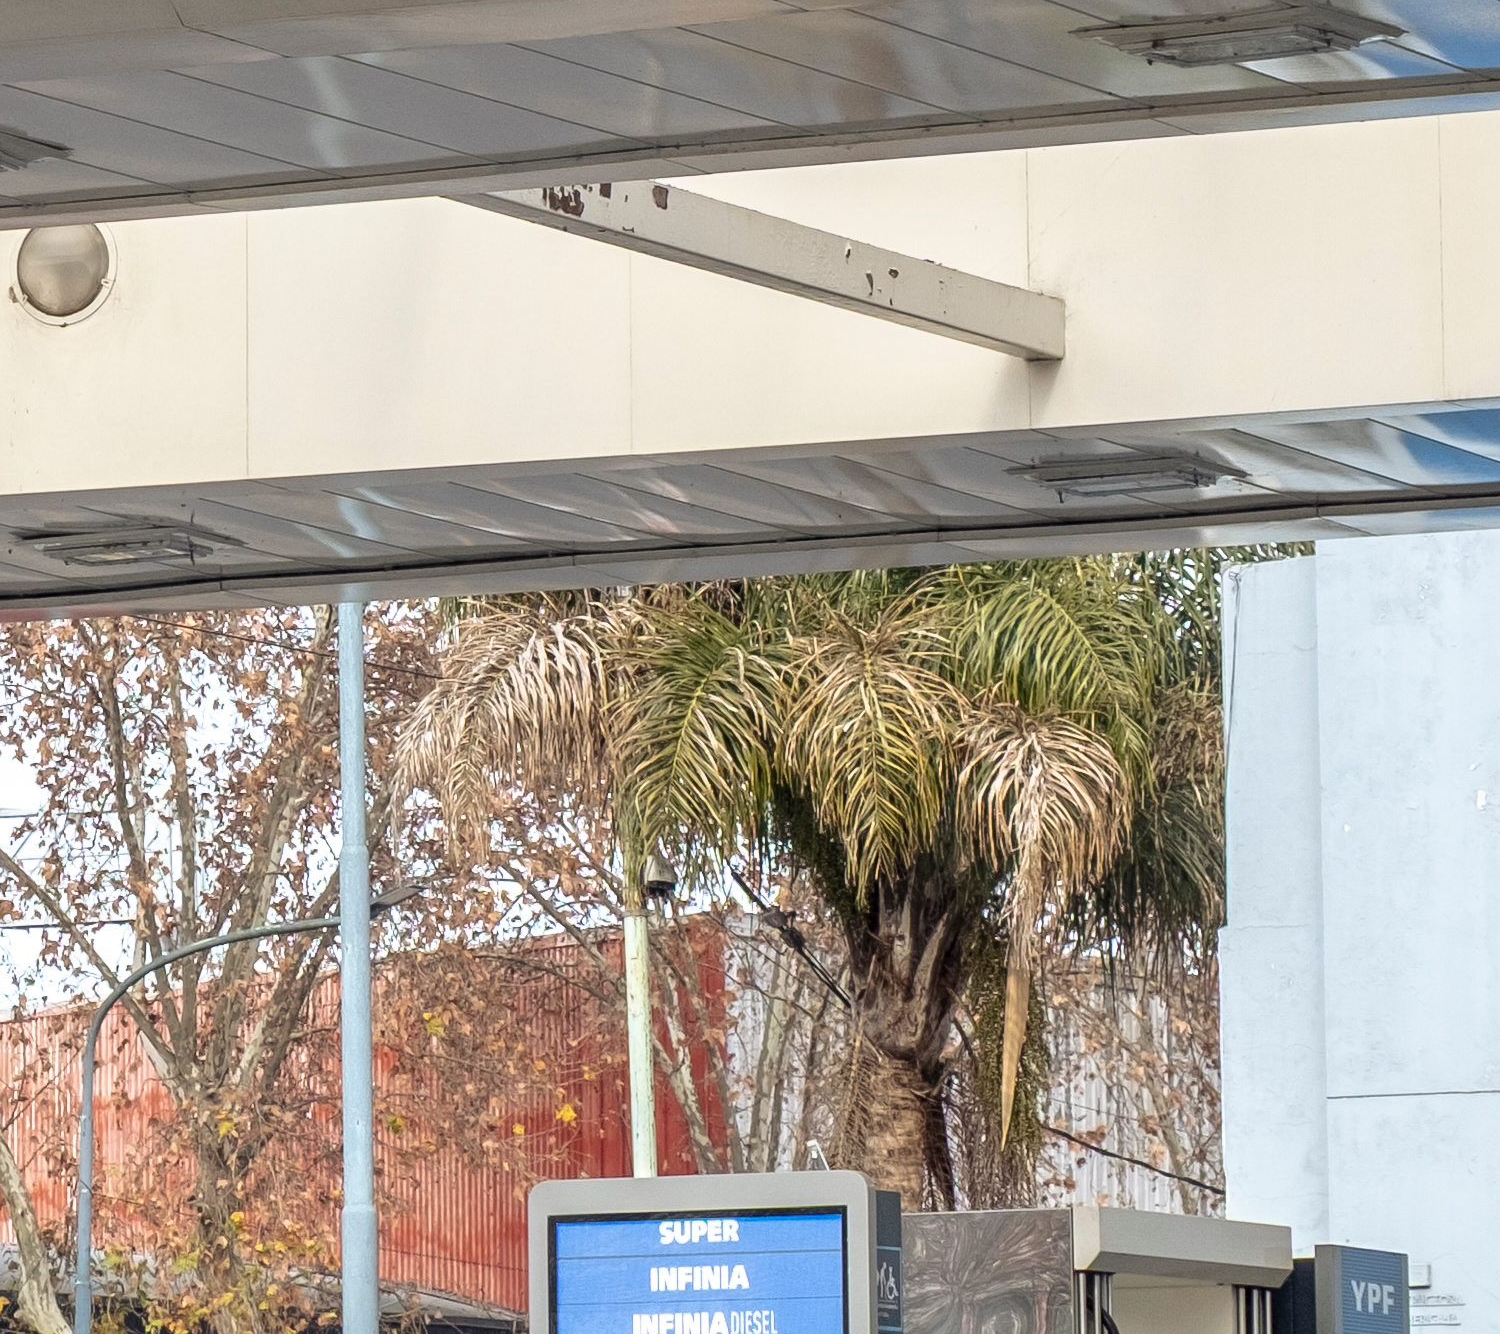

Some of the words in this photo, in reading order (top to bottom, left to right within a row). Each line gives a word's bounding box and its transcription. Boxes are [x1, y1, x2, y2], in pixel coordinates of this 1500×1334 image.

[659, 1220, 740, 1245] SUPER
[650, 1265, 750, 1292] INFINIA
[1351, 1280, 1396, 1315] YPF
